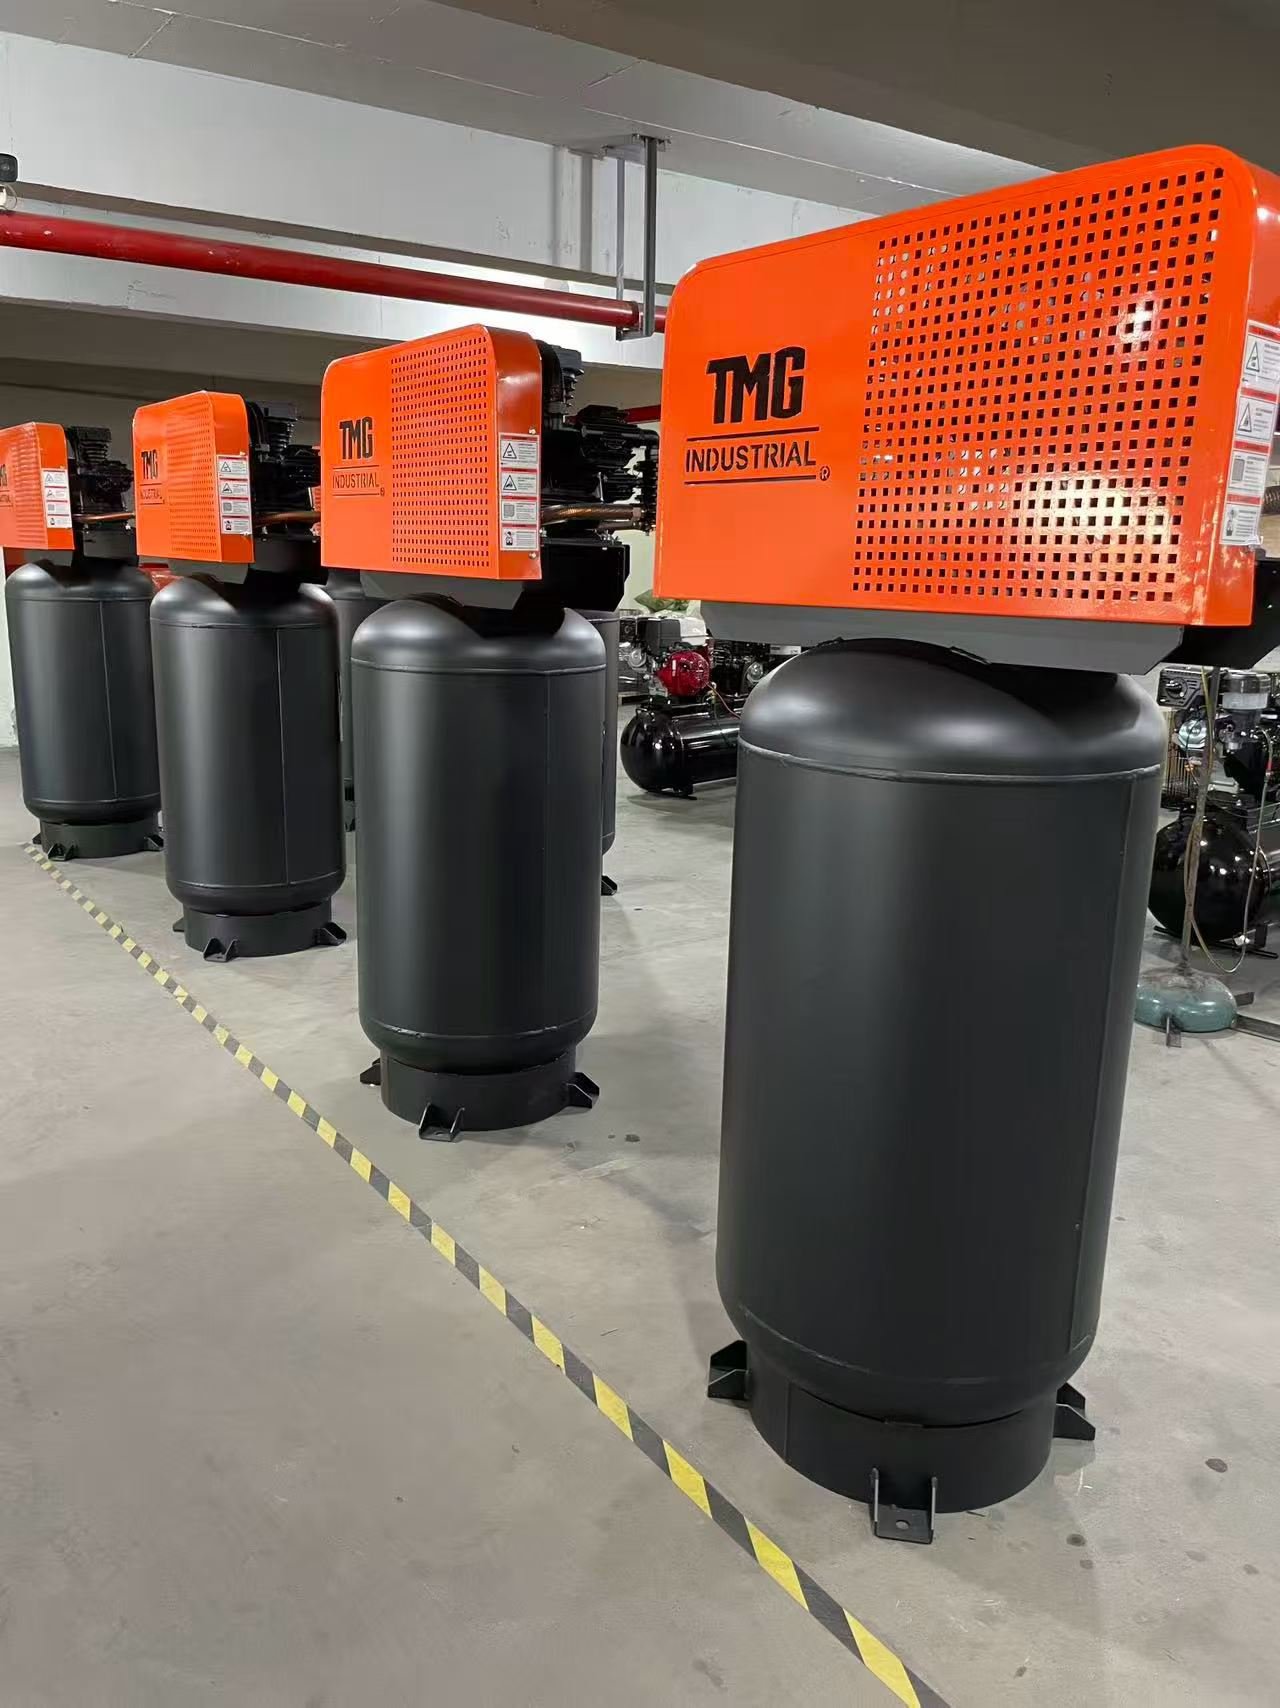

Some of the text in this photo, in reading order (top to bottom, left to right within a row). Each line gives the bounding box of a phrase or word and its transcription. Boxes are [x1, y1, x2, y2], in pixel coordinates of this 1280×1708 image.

[706, 346, 806, 424] TMG
[339, 416, 373, 460] TMG
[685, 440, 817, 472] INDUSTRIAL
[332, 472, 380, 489] INDUSTRIAL
